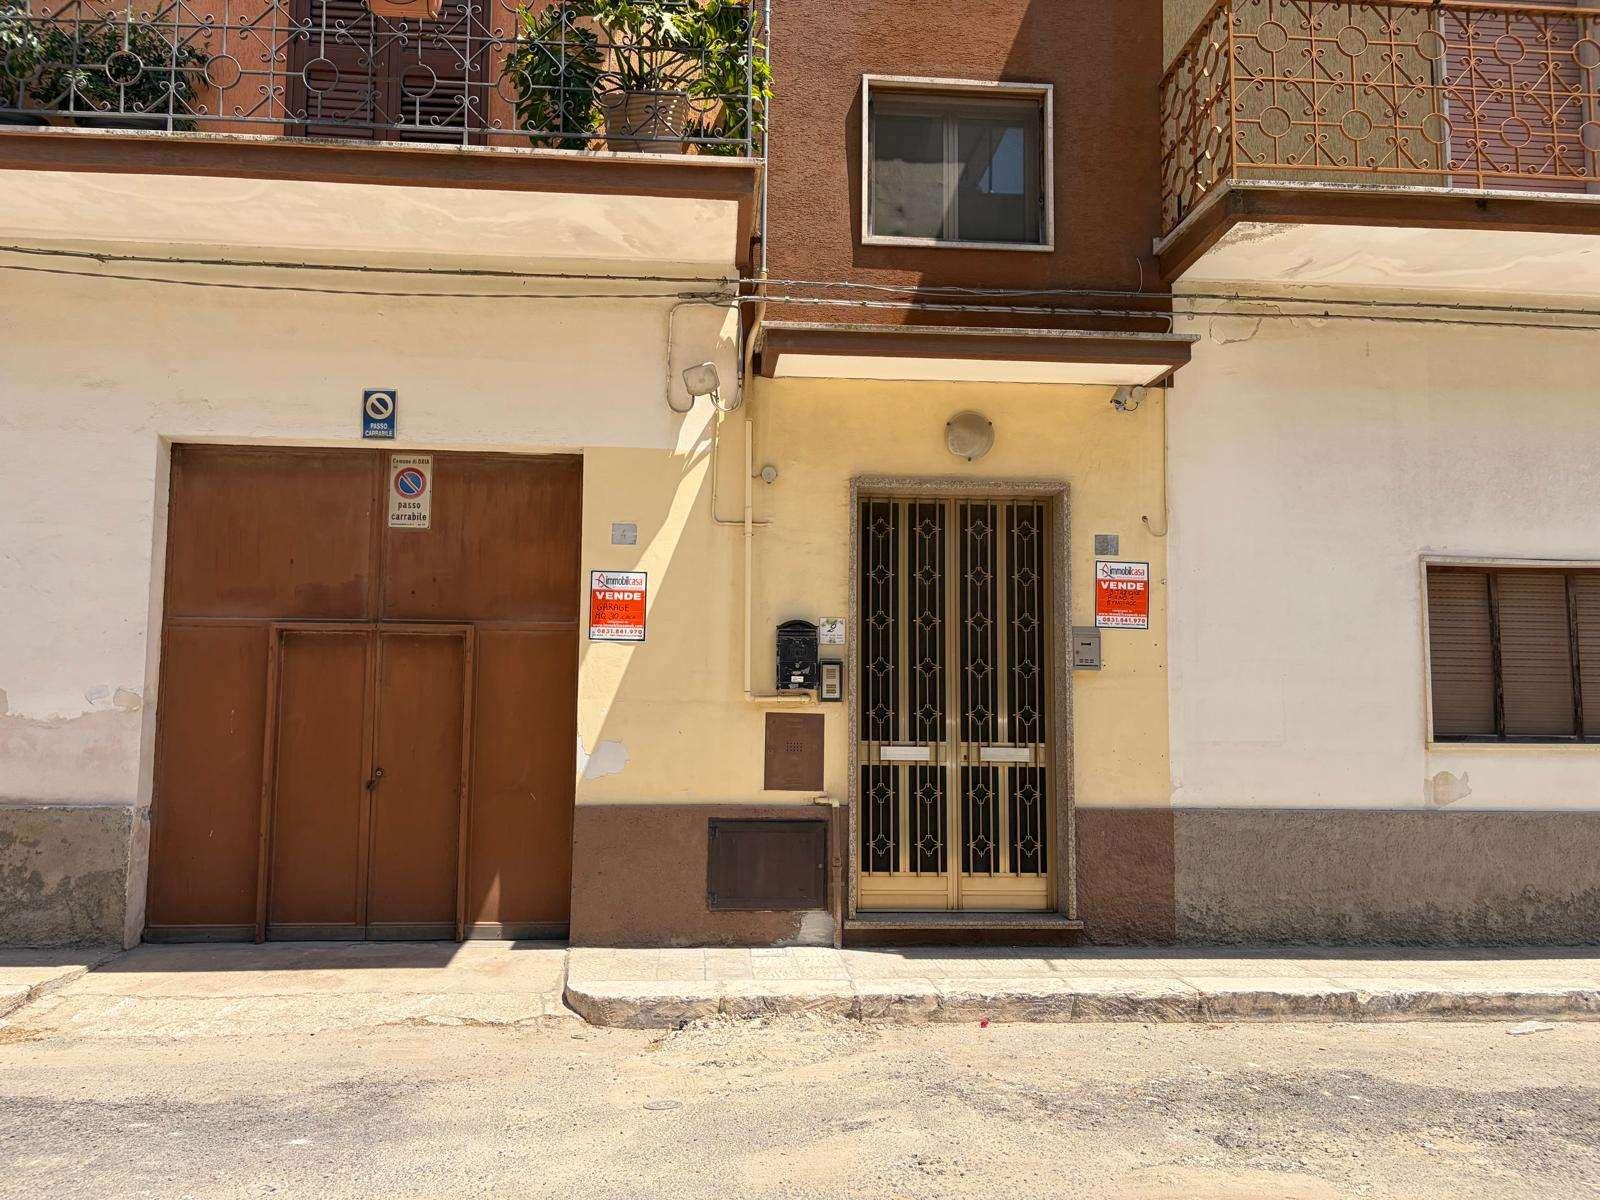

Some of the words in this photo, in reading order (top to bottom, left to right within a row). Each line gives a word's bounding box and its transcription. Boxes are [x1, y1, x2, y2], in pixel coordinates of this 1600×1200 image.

[370, 422, 388, 430] PASSO
[398, 502, 421, 511] passo
[391, 512, 427, 521] carrabile
[1101, 581, 1145, 590] VENDE
[595, 591, 642, 600] VENDE
[596, 603, 630, 612] GARAGE
